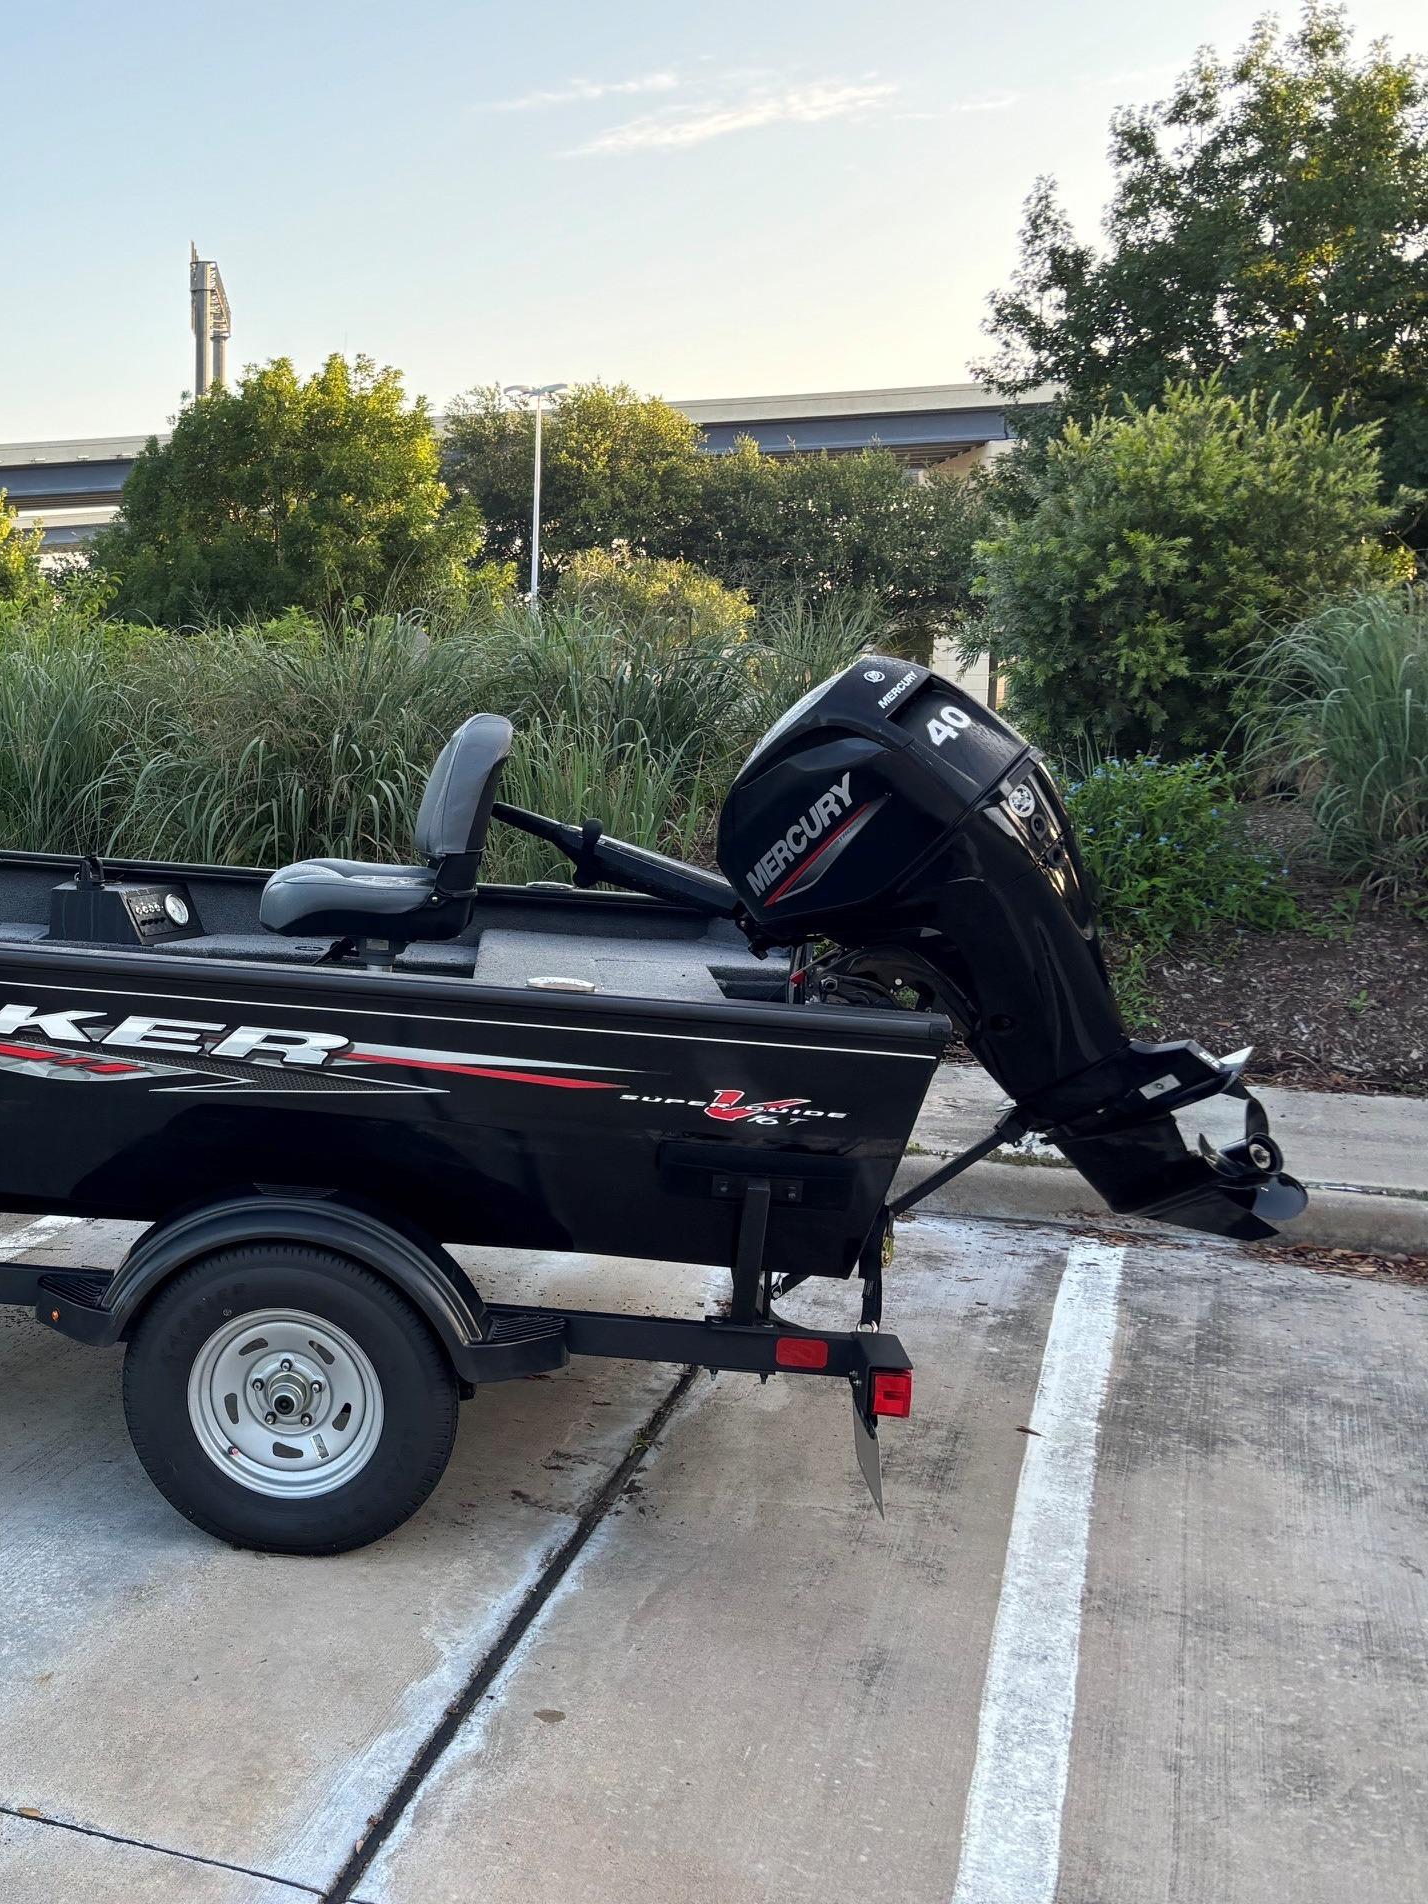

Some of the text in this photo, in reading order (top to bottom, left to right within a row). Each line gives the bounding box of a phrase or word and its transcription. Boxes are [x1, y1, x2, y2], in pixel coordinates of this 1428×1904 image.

[878, 670, 918, 709] MERCURY
[926, 706, 972, 747] 40
[746, 771, 853, 897] MERCURY
[620, 1094, 849, 1119] SUPER GUIDE
